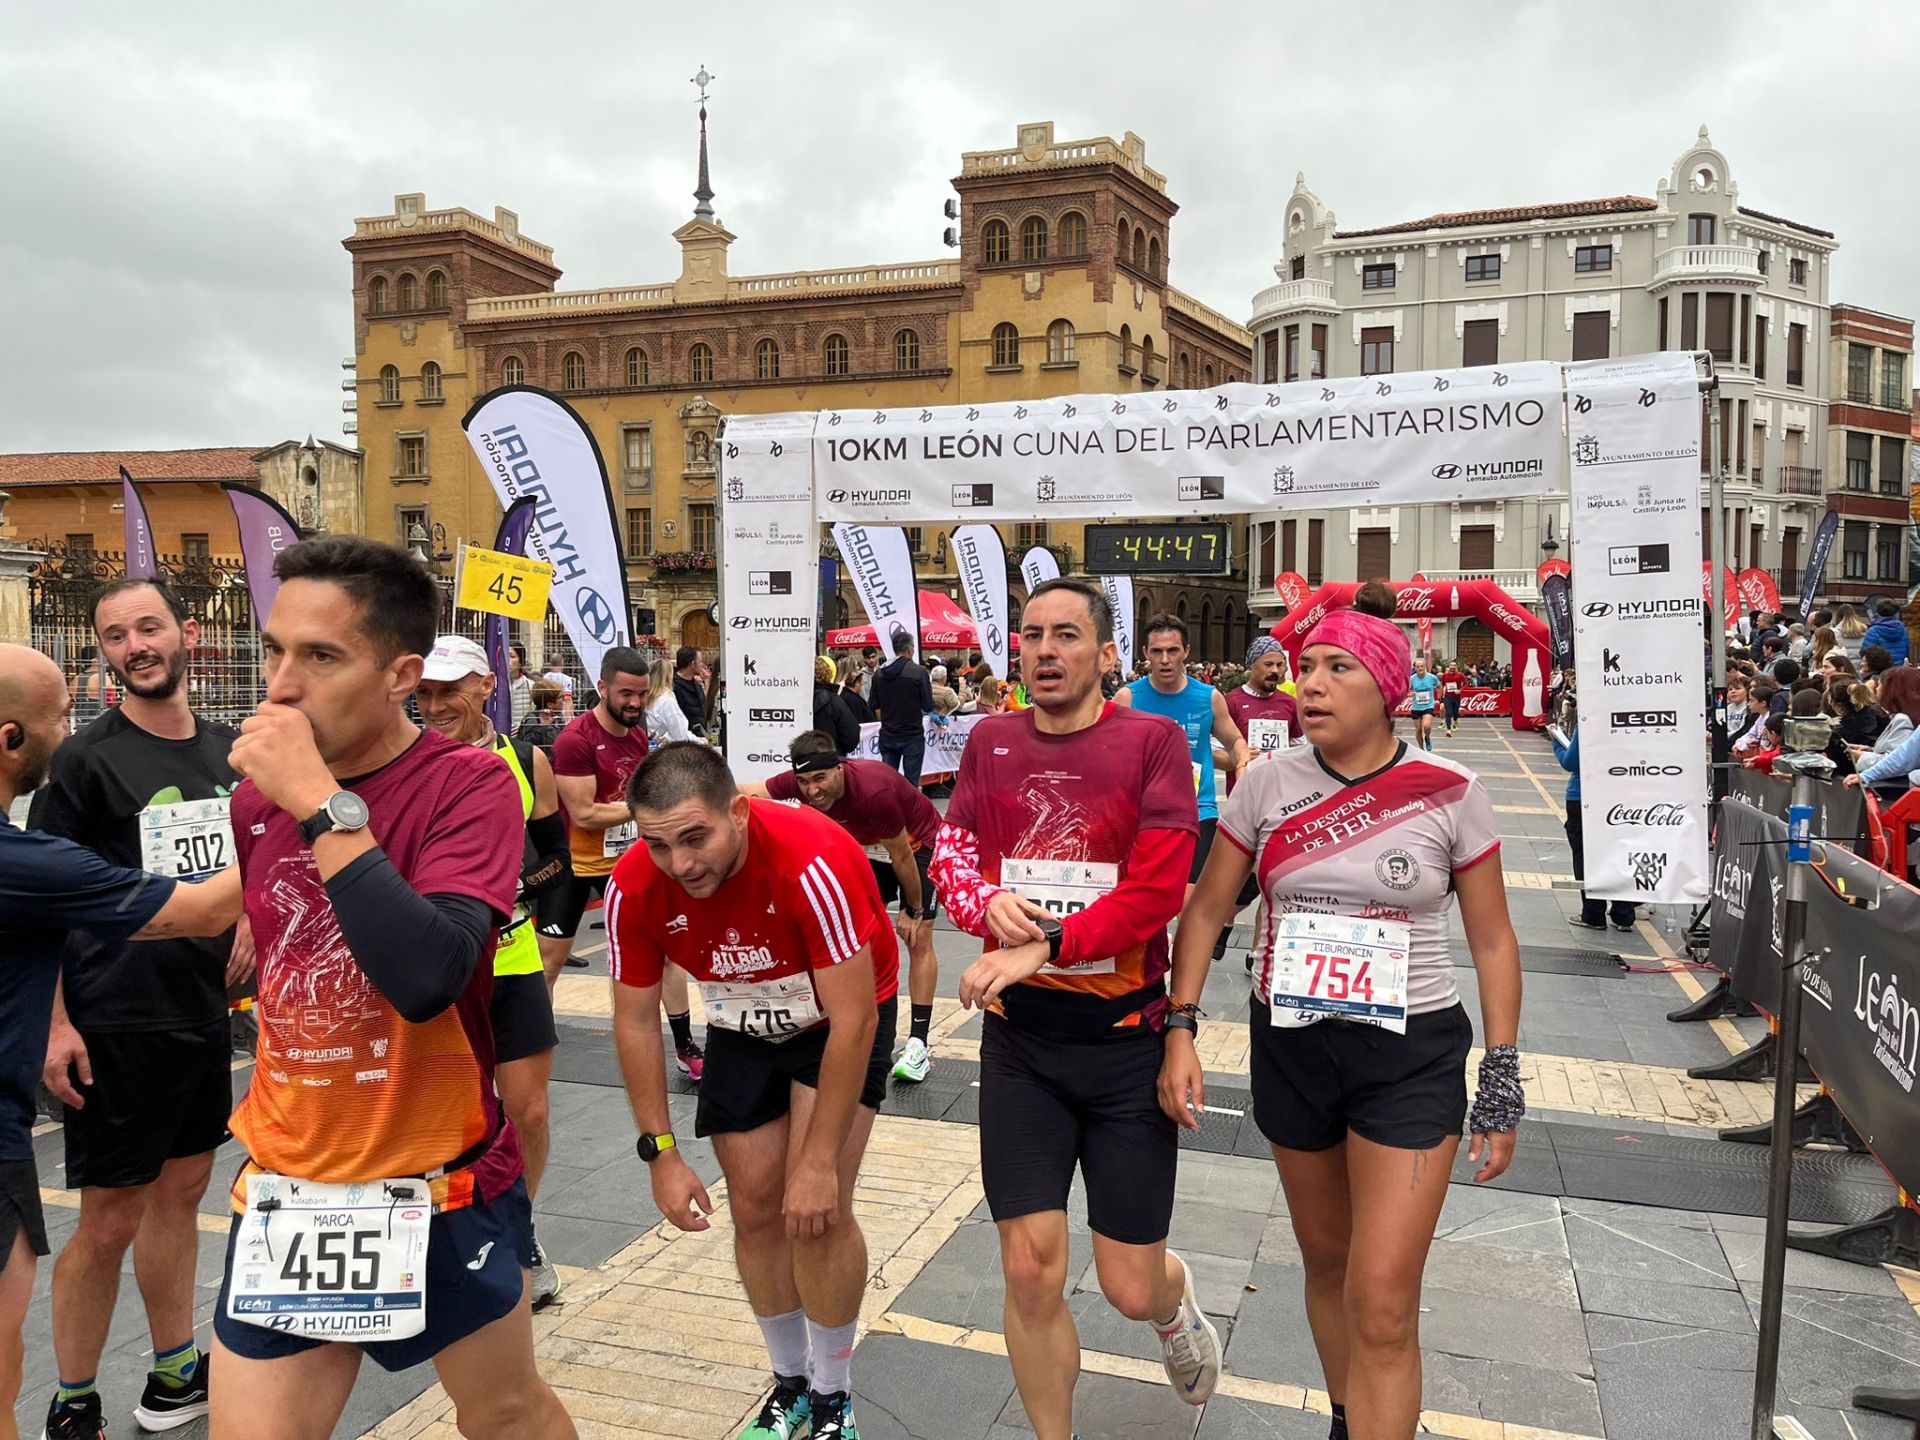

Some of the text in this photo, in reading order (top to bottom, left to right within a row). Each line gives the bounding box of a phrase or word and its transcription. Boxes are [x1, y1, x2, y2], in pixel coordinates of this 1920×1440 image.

[827, 399, 1544, 462] 10KM LEÓN CUNA DEL PARLAMENTARISMO
[1602, 451, 1662, 462] AYUNTAMIENTO
[1676, 448, 1698, 456] LEÓN
[1466, 458, 1542, 476] HYUNDAI
[1466, 471, 1542, 482] Lemauto Automoción
[852, 490, 911, 501] HYUNDAI
[1632, 506, 1660, 514] Castilla
[1612, 555, 1637, 565] LEÓN
[488, 572, 524, 604] 45
[1618, 598, 1700, 614] HYUNDAI
[1652, 610, 1700, 619] Automoción
[754, 617, 811, 628] HYUNDAI
[835, 632, 868, 644] Coca-Cola
[925, 631, 960, 644] Coca-Cola
[744, 677, 800, 688] kutxabank
[1604, 672, 1682, 686] kutxabank
[1262, 734, 1280, 749] 521
[1608, 760, 1682, 777] emico
[1280, 790, 1324, 817] Joma
[1284, 791, 1376, 844] LA DESPENSA
[1606, 803, 1687, 826] Coca-Cola
[1302, 800, 1425, 854] DE FER Running
[174, 832, 227, 875] 302
[1294, 892, 1340, 906] Huerta
[712, 946, 772, 967] BILBAO
[1313, 942, 1374, 958] TIBURONCIN
[1305, 953, 1374, 1002] 754
[304, 1046, 352, 1058] HYUNDAI
[313, 1214, 355, 1227] MARCA
[280, 1230, 382, 1291] 455
[304, 1314, 391, 1330] HYUNDAI
